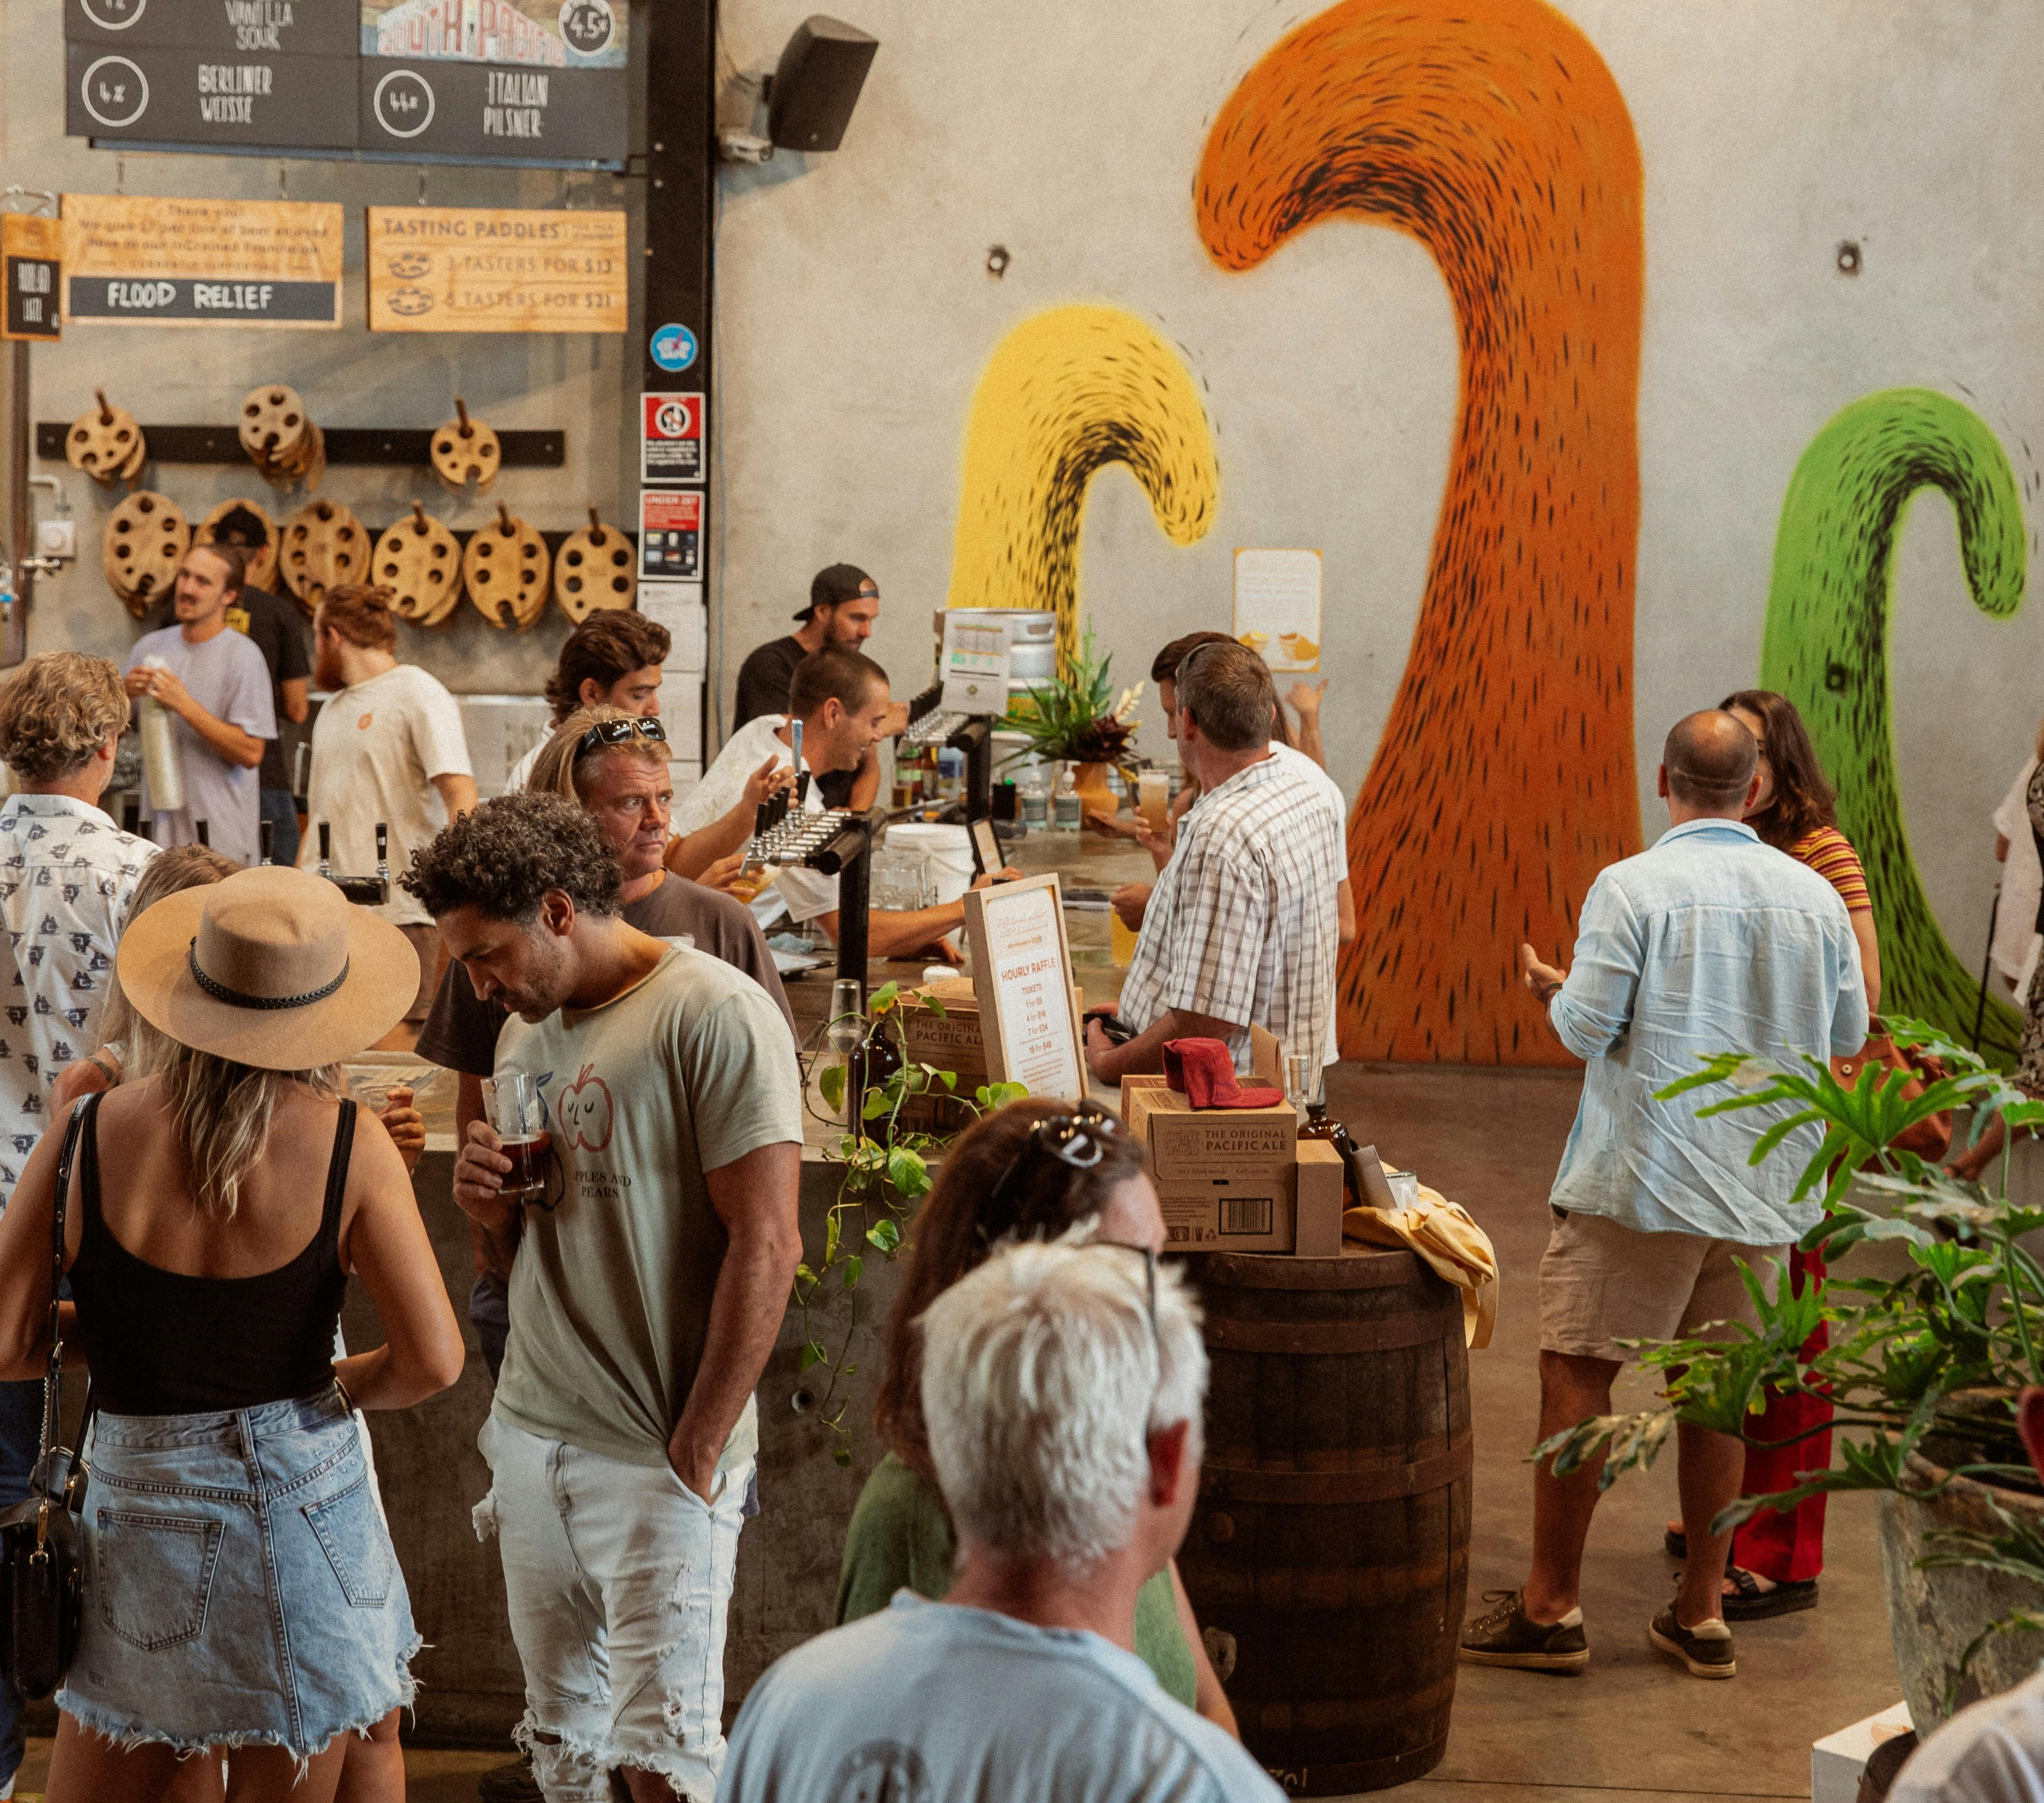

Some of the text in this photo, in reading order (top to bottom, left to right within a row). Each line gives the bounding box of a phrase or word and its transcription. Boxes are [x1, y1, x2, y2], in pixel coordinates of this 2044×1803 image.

[236, 25, 281, 51] SOUR
[198, 64, 272, 95] BERLINER
[489, 71, 548, 107] ITALIAN
[484, 106, 542, 138] PILSNER
[383, 218, 560, 239] TASTING PADDLES
[464, 256, 537, 273] TASTERS
[543, 258, 578, 273] FOR
[107, 281, 274, 310] FLOOD RELIEF
[464, 291, 537, 308] TASTERS
[543, 292, 578, 308] FOR
[1001, 957, 1056, 982] HOURLY RAFFLE
[1022, 983, 1042, 995] TICKETS
[916, 1021, 982, 1034] THE ORIGINA
[916, 1030, 961, 1043] PACIFIC
[965, 1036, 984, 1045] AL
[1205, 1130, 1286, 1139] THE ORIGINAL
[1206, 1140, 1286, 1151] PACIFIC ALE
[582, 1186, 619, 1199] PEARS
